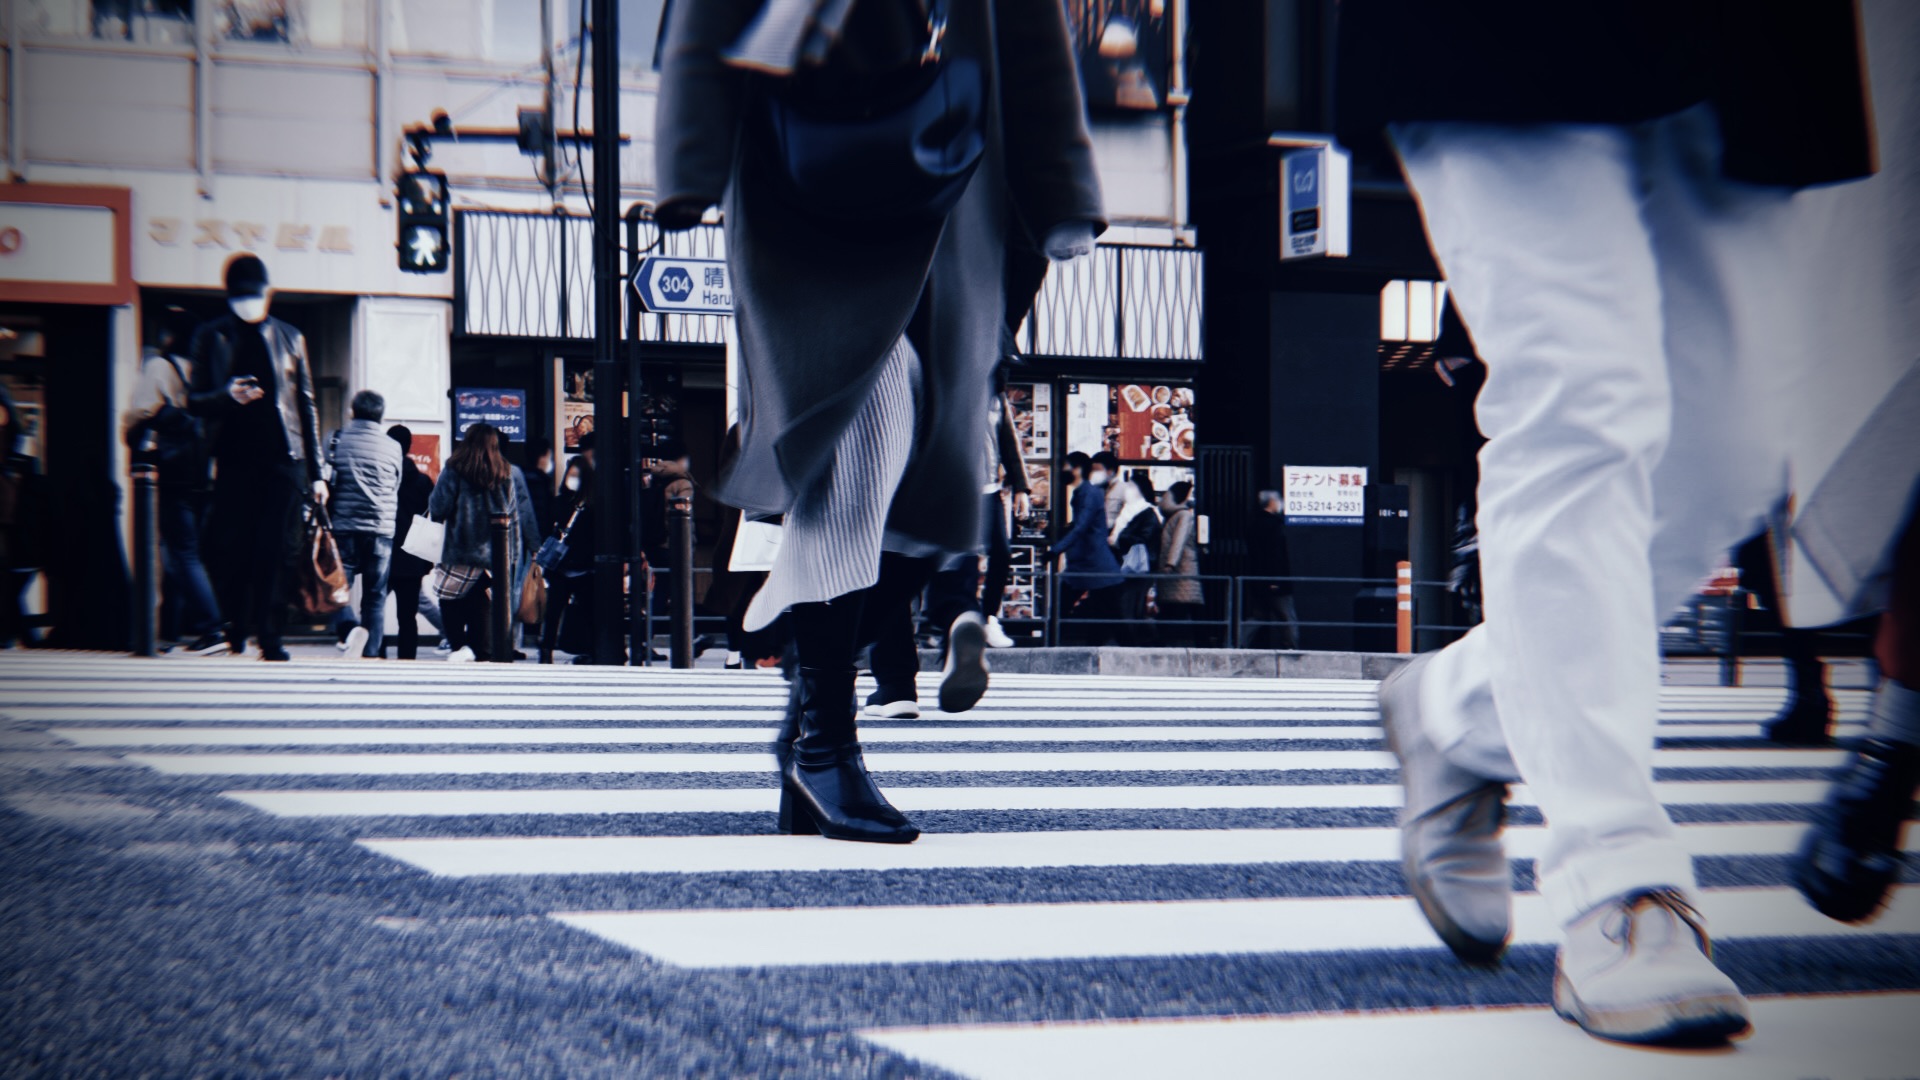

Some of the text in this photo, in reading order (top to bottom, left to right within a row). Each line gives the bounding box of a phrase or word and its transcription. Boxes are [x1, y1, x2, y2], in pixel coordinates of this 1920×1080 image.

[662, 275, 690, 294] 304
[702, 290, 731, 305] Haru
[1289, 473, 1362, 487] テナント募集
[1289, 501, 1361, 512] 03-5214-2931
